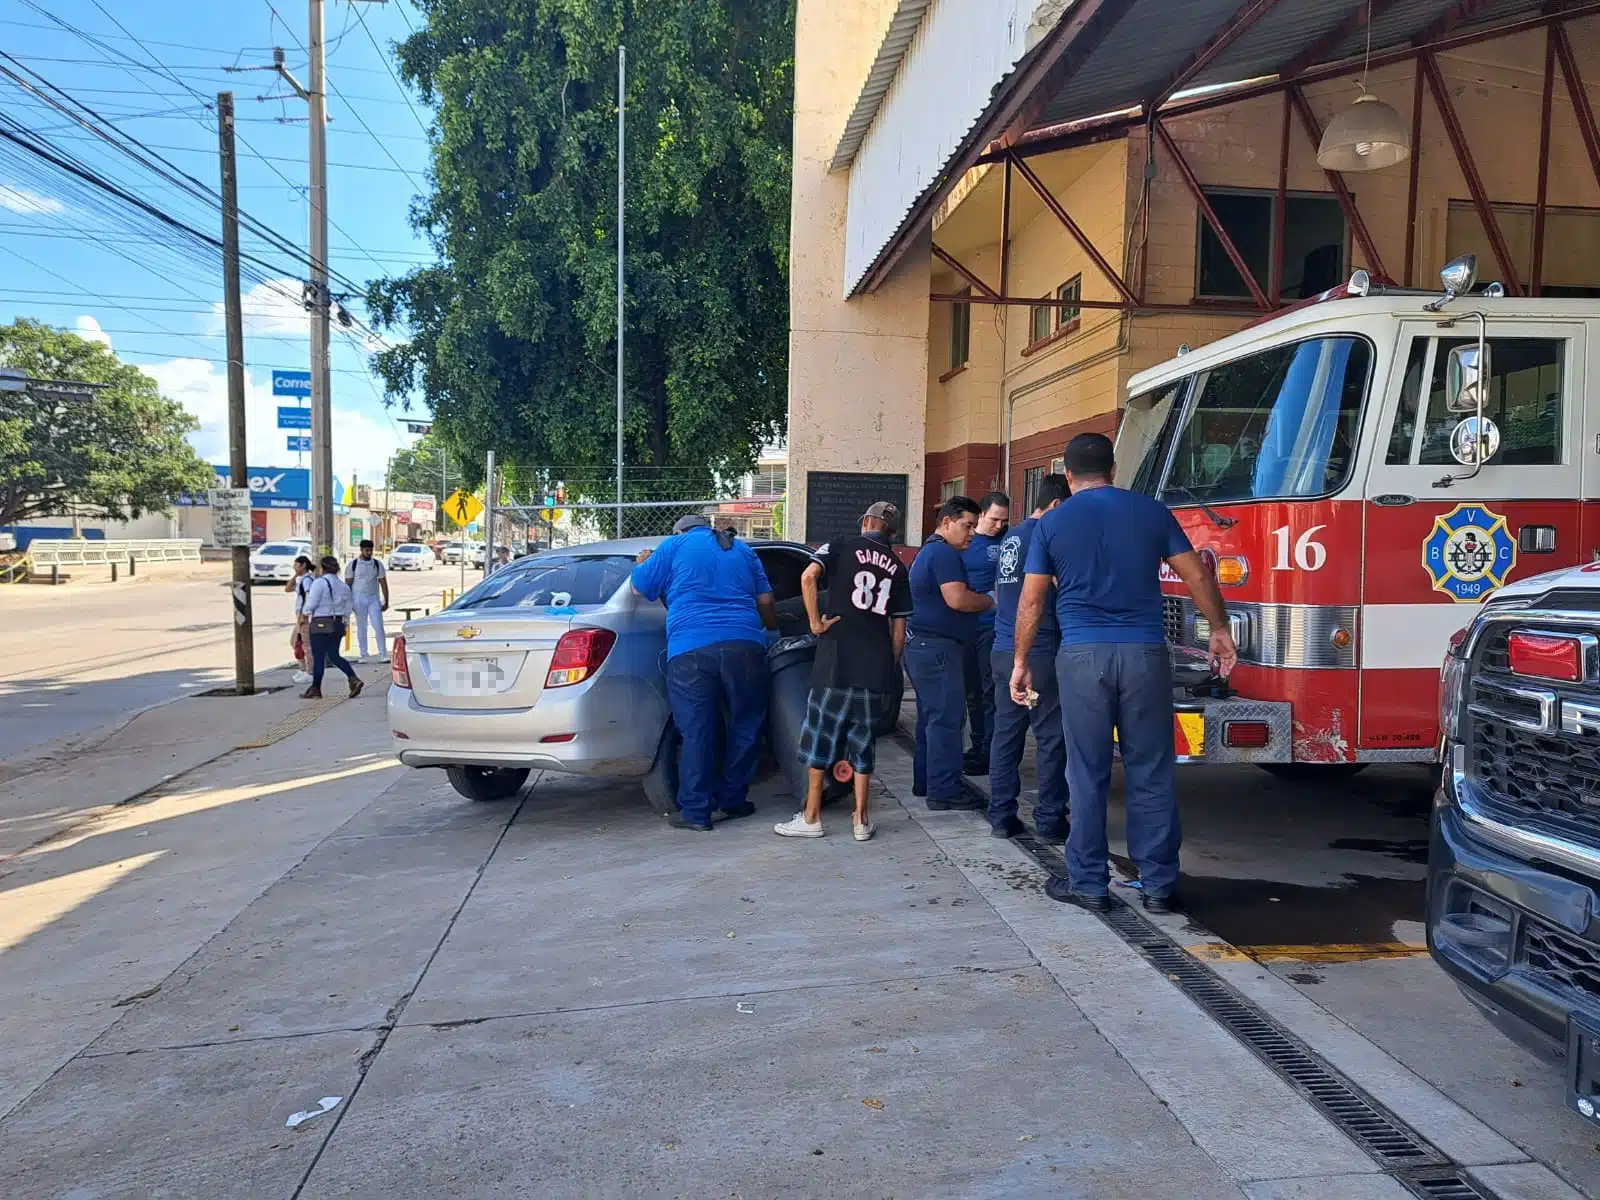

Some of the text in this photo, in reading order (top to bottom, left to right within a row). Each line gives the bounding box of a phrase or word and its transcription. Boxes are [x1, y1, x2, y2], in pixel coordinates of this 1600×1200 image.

[275, 376, 312, 389] Come
[1466, 509, 1477, 523] V
[1270, 524, 1328, 571] 16
[1431, 546, 1509, 560] B C
[855, 548, 898, 576] GARCIA
[851, 570, 892, 616] 81
[1456, 583, 1481, 595] 1949
